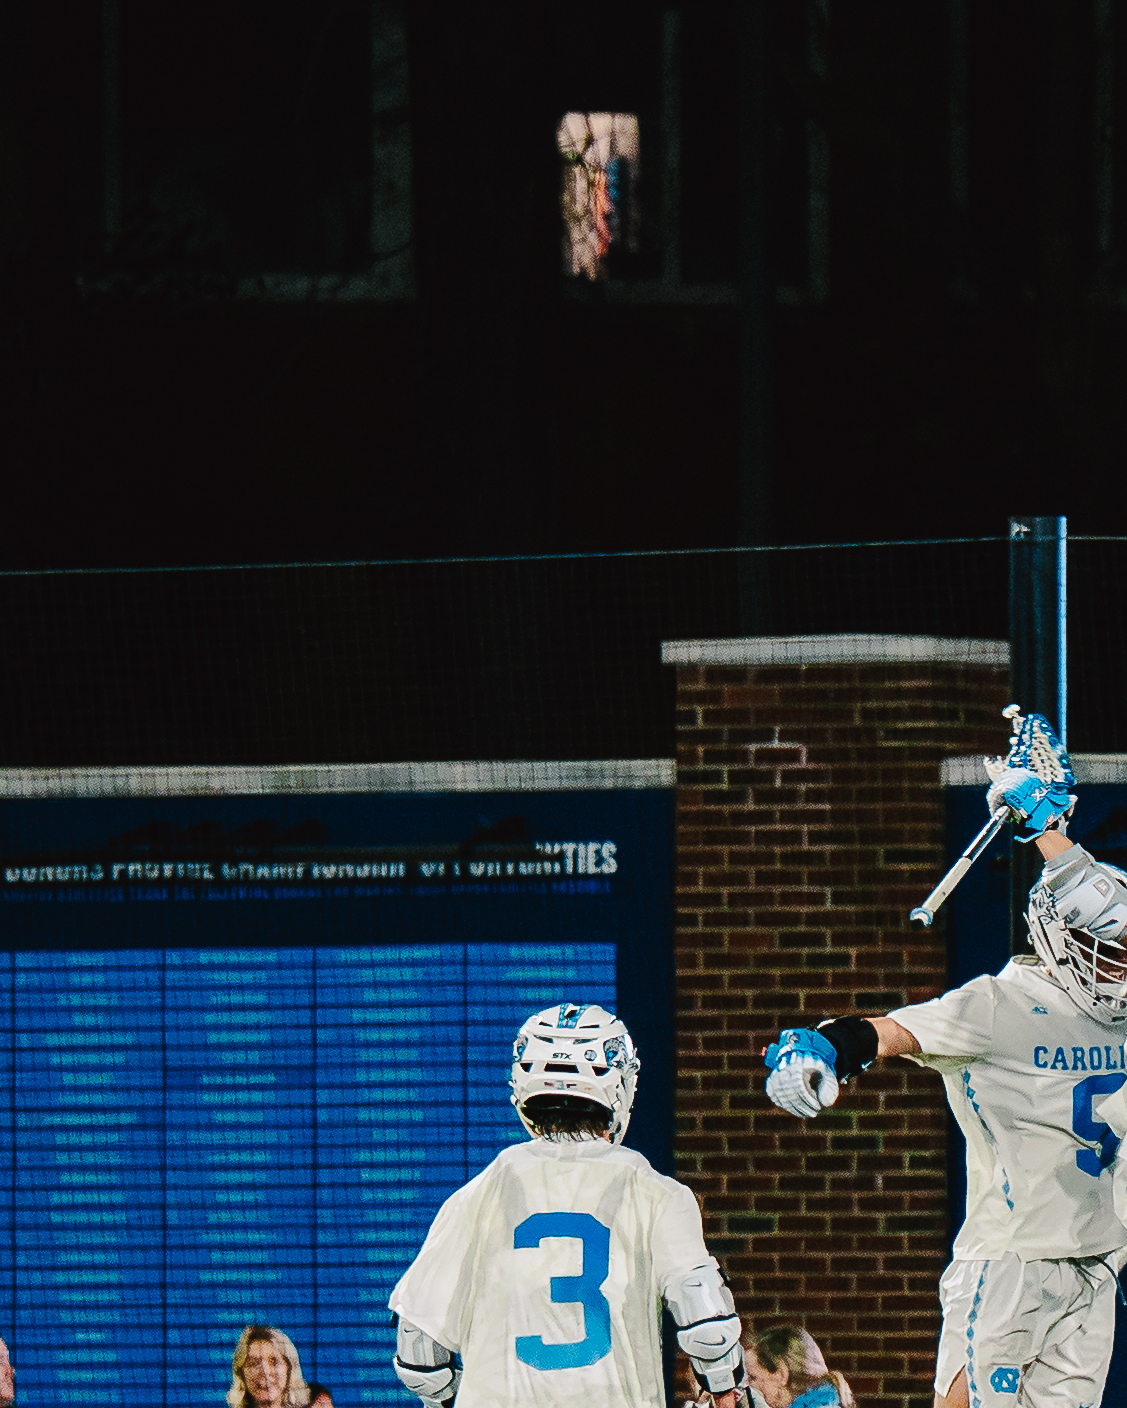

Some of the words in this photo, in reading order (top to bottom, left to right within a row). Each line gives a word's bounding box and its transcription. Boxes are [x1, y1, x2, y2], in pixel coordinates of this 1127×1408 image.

[552, 1052, 573, 1060] STX
[1033, 1045, 1126, 1071] CAROLI
[513, 1211, 612, 1371] 3
